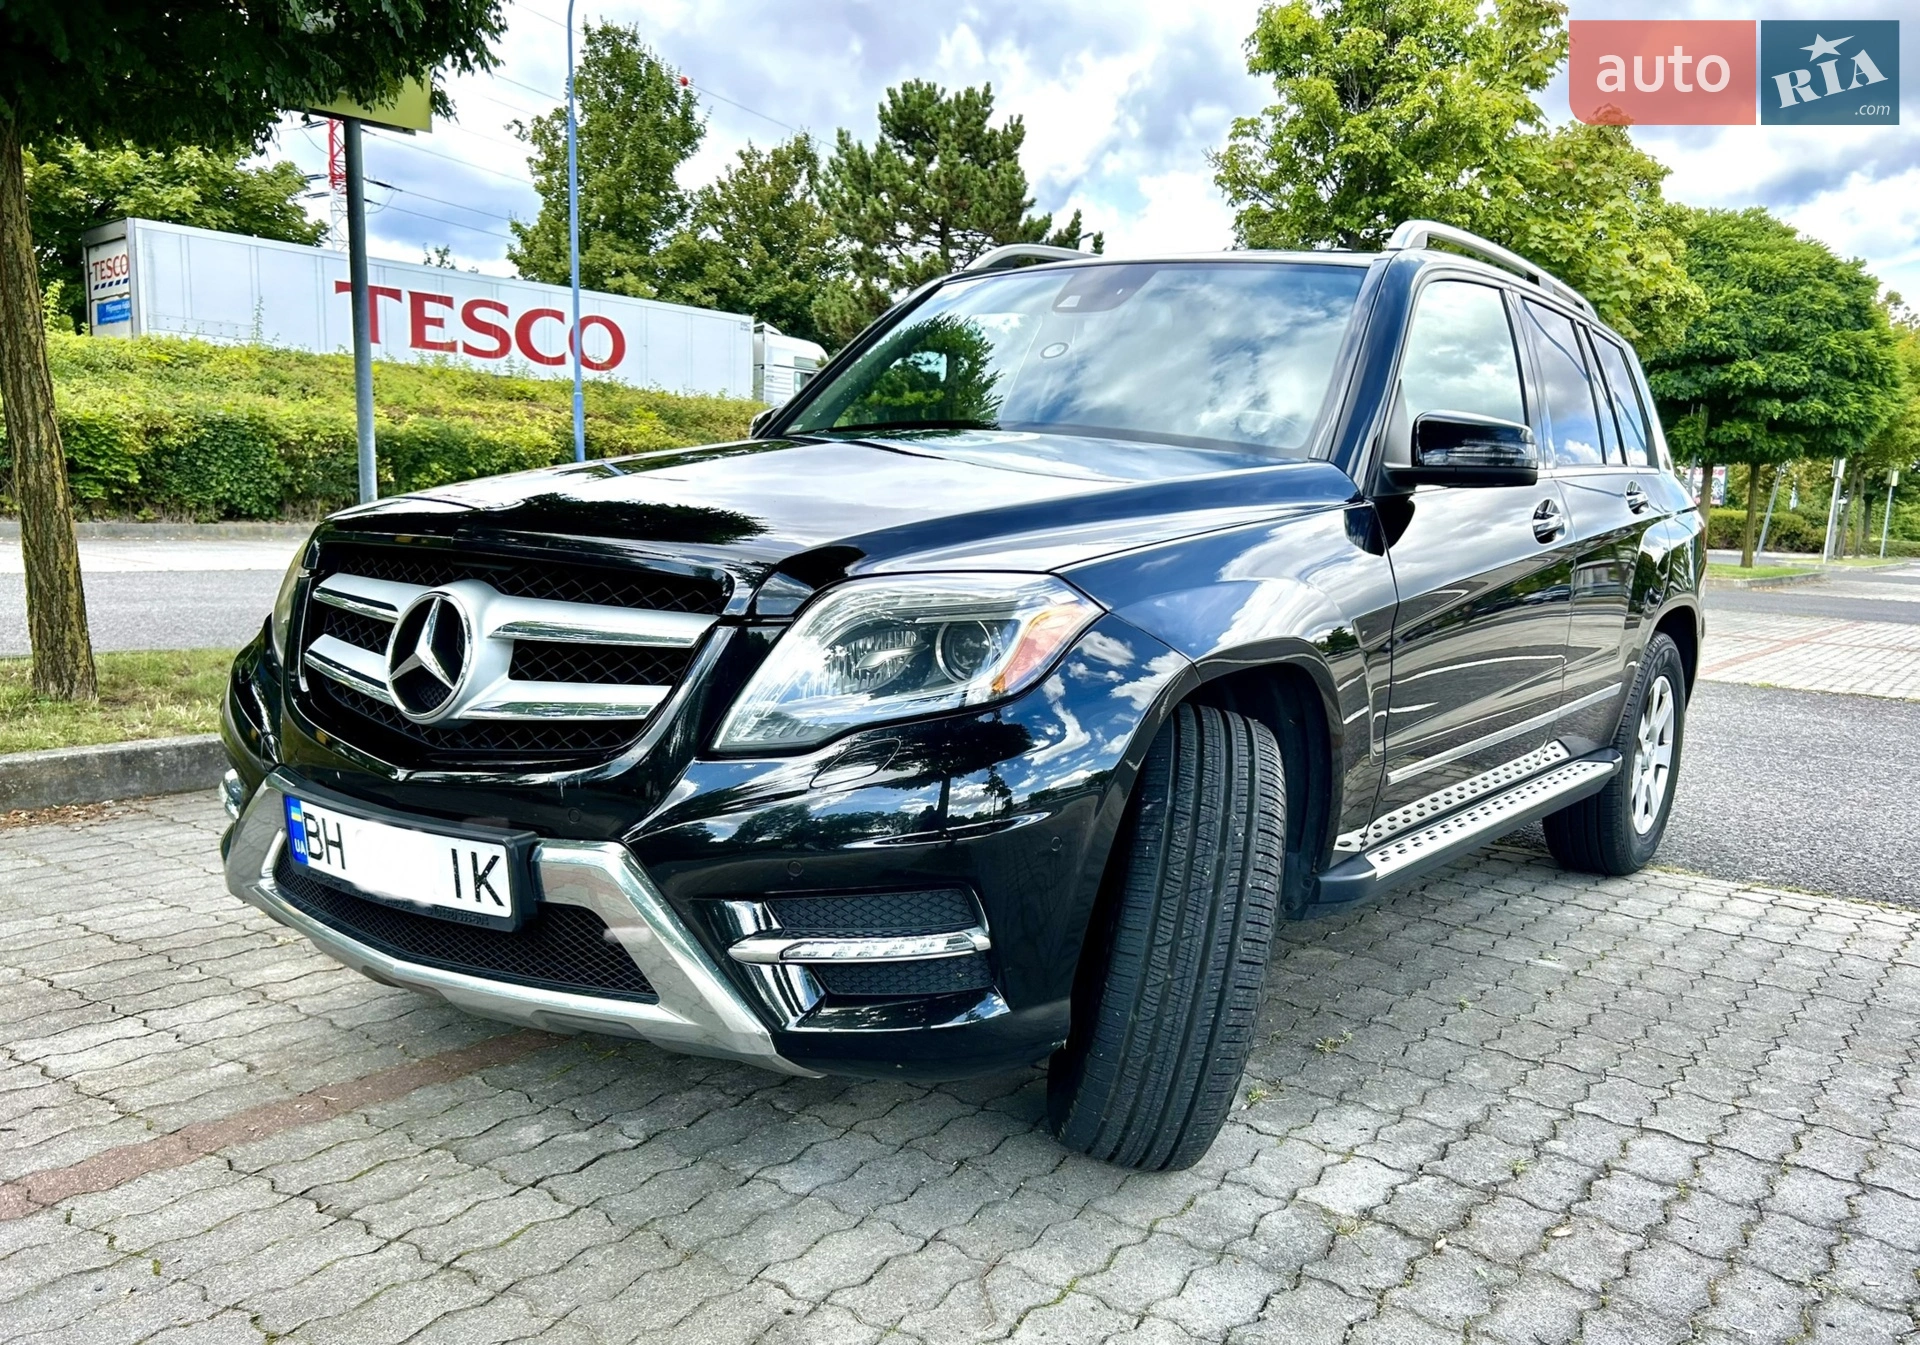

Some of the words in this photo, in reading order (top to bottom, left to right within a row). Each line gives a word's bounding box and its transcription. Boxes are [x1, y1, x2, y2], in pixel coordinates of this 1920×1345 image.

[92, 254, 129, 281] TESCO
[335, 280, 626, 371] TESCO
[294, 838, 306, 856] UA
